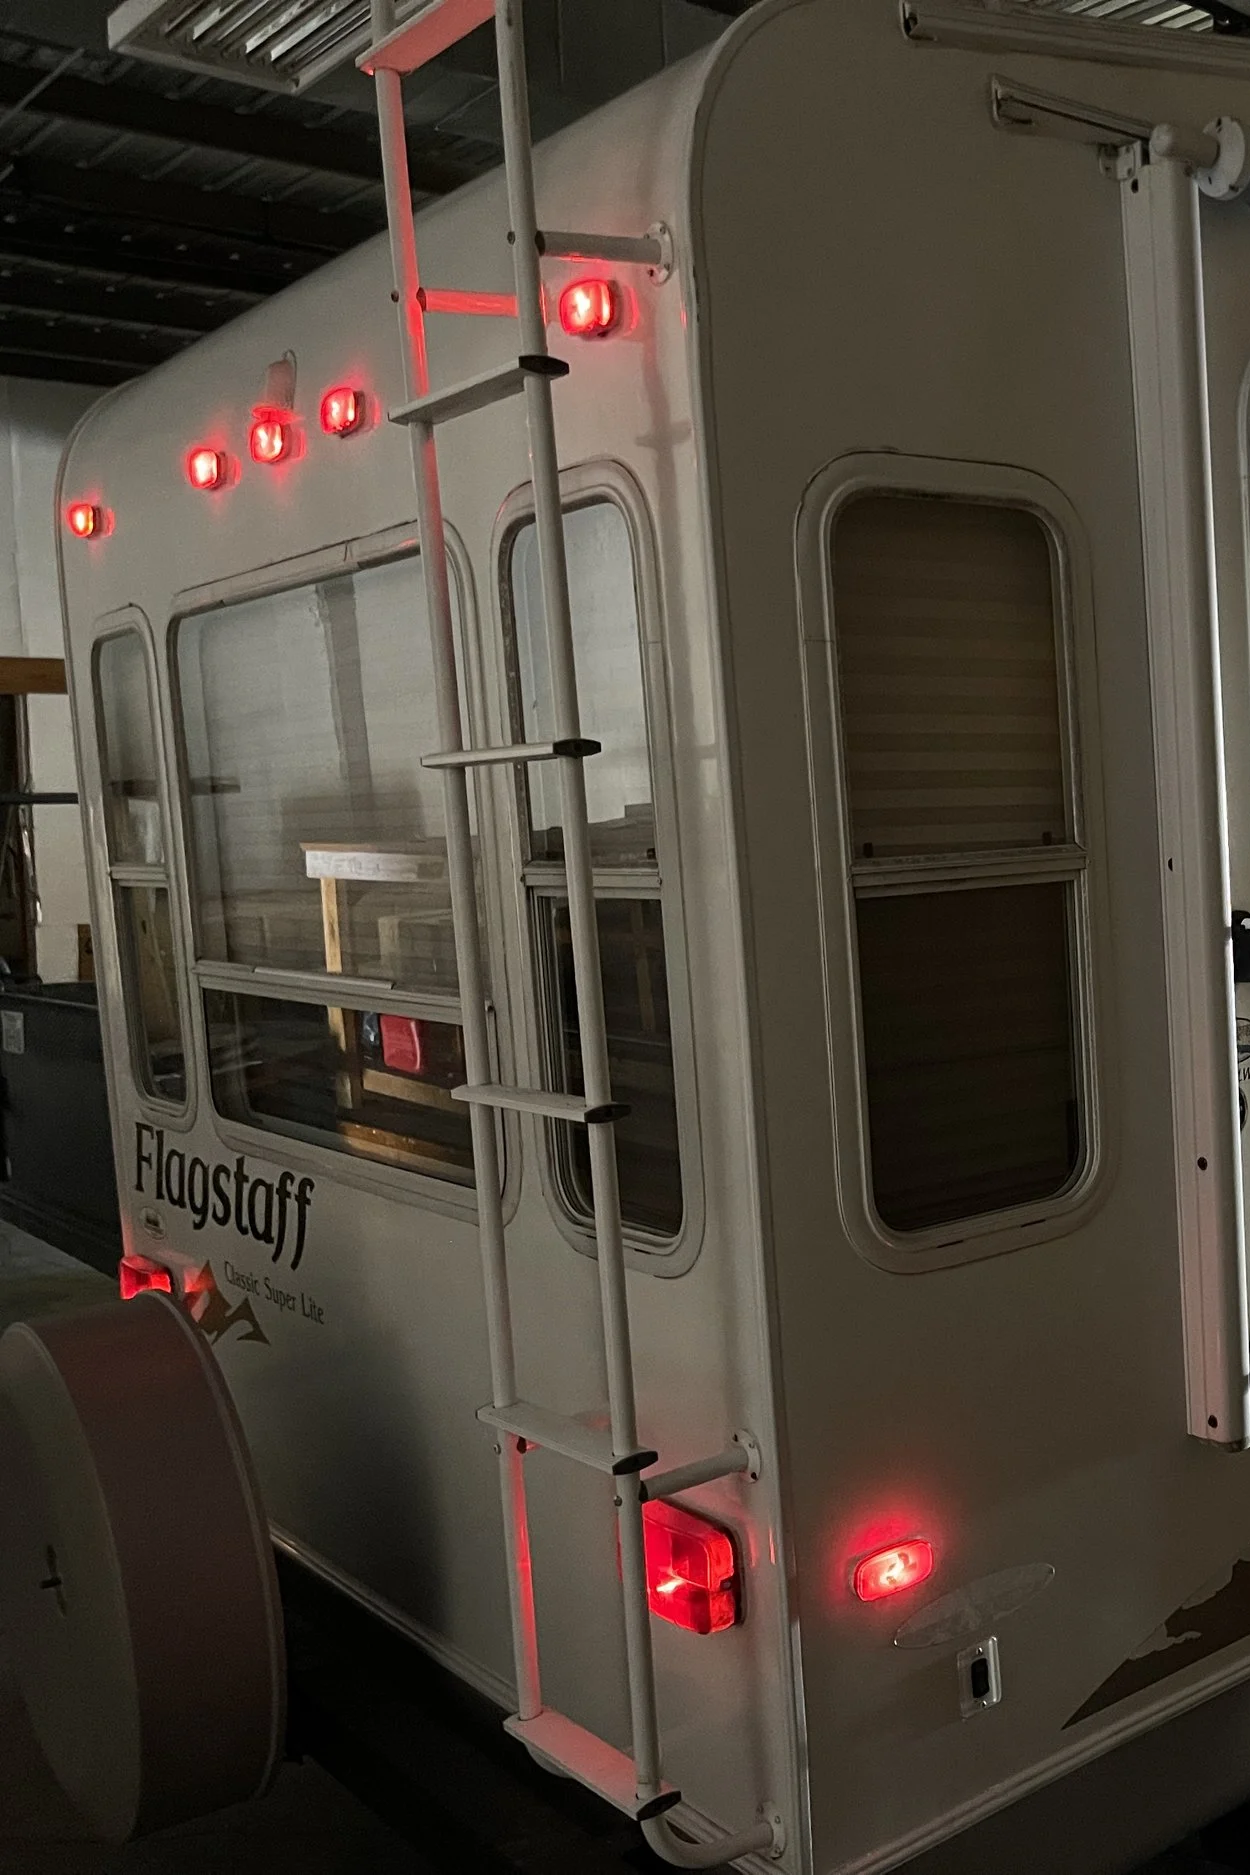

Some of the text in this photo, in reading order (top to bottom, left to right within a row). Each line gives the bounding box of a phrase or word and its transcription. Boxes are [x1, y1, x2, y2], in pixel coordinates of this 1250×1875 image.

[135, 1122, 316, 1271] Flagstaff
[223, 1261, 326, 1325] Classic Super Lite
